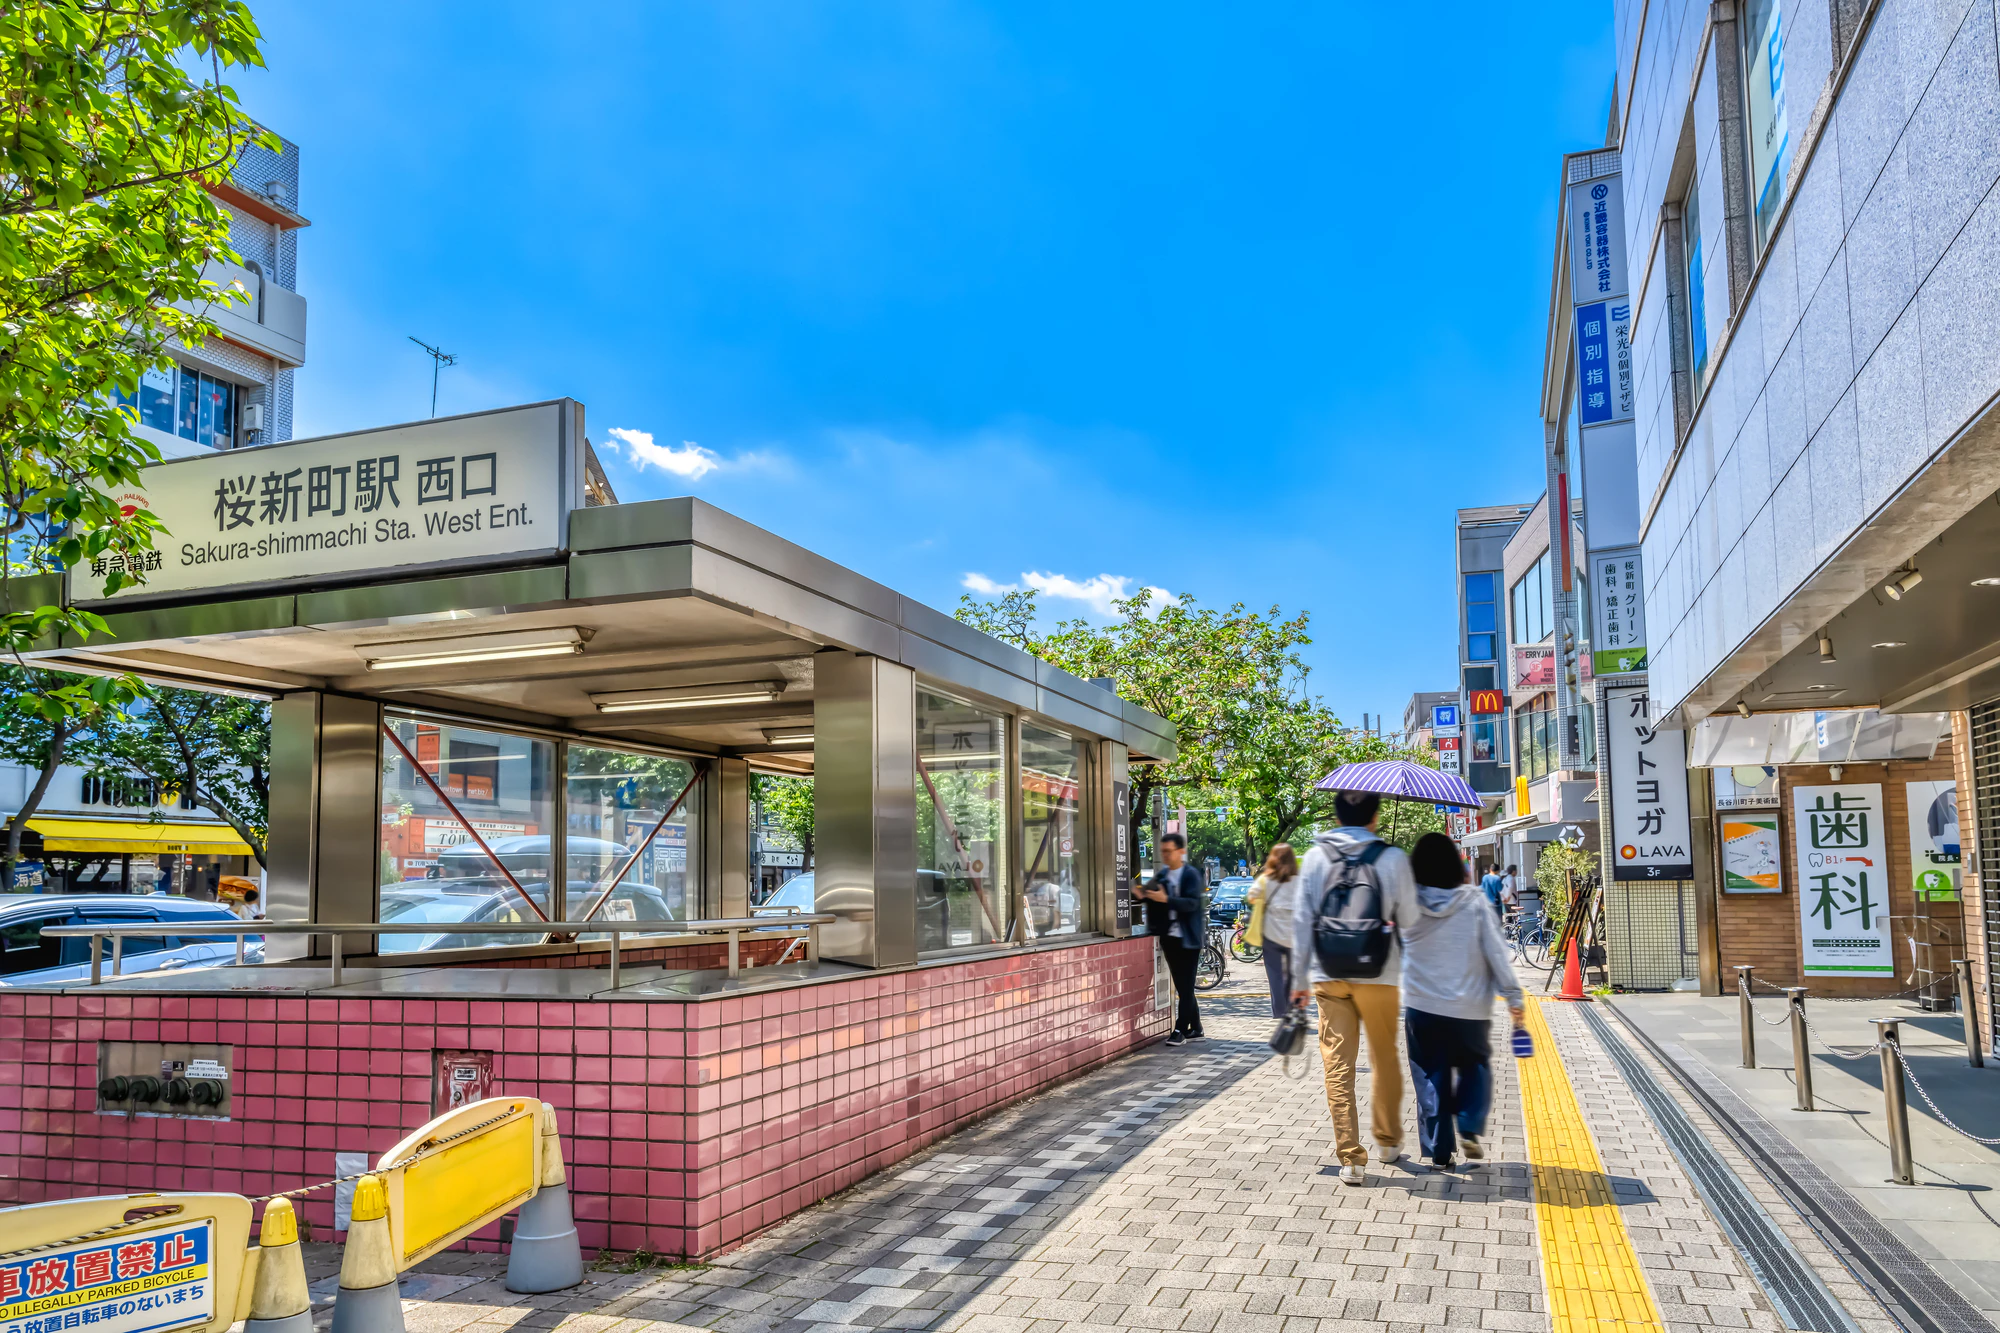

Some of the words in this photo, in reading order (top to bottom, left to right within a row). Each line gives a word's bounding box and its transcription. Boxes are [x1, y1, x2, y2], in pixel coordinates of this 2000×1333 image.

[1584, 320, 1605, 408] 個別指導
[1616, 324, 1631, 412] 栄光の個別ビザビ
[123, 493, 151, 509] RAILWAYS
[214, 454, 400, 532] 桜新町駅
[416, 452, 497, 506] 西口
[180, 521, 367, 566] Sakura-shimmachi
[374, 516, 416, 543] Sta.
[424, 508, 482, 536] West
[489, 502, 534, 529] Ent.
[91, 550, 163, 577] 東急電鉄
[1605, 564, 1619, 646] 歯科・矯正歯科
[1625, 561, 1639, 644] 桜新町グリーン
[1441, 761, 1458, 769] 客席
[1443, 752, 1456, 760] 2F
[1630, 693, 1666, 836] ホットヨガ
[1717, 797, 1779, 807] 長谷川町子美術館
[1804, 791, 1872, 849] 歯
[1639, 845, 1686, 858] LAVA
[1646, 866, 1661, 877] 3F
[1825, 855, 1844, 864] B1F
[1809, 871, 1879, 931] 科
[0, 1233, 195, 1301] 車放置禁止
[13, 1293, 85, 1317] ILLEGALLY
[88, 1281, 140, 1299] PARKED
[143, 1268, 195, 1287] BICYCLE
